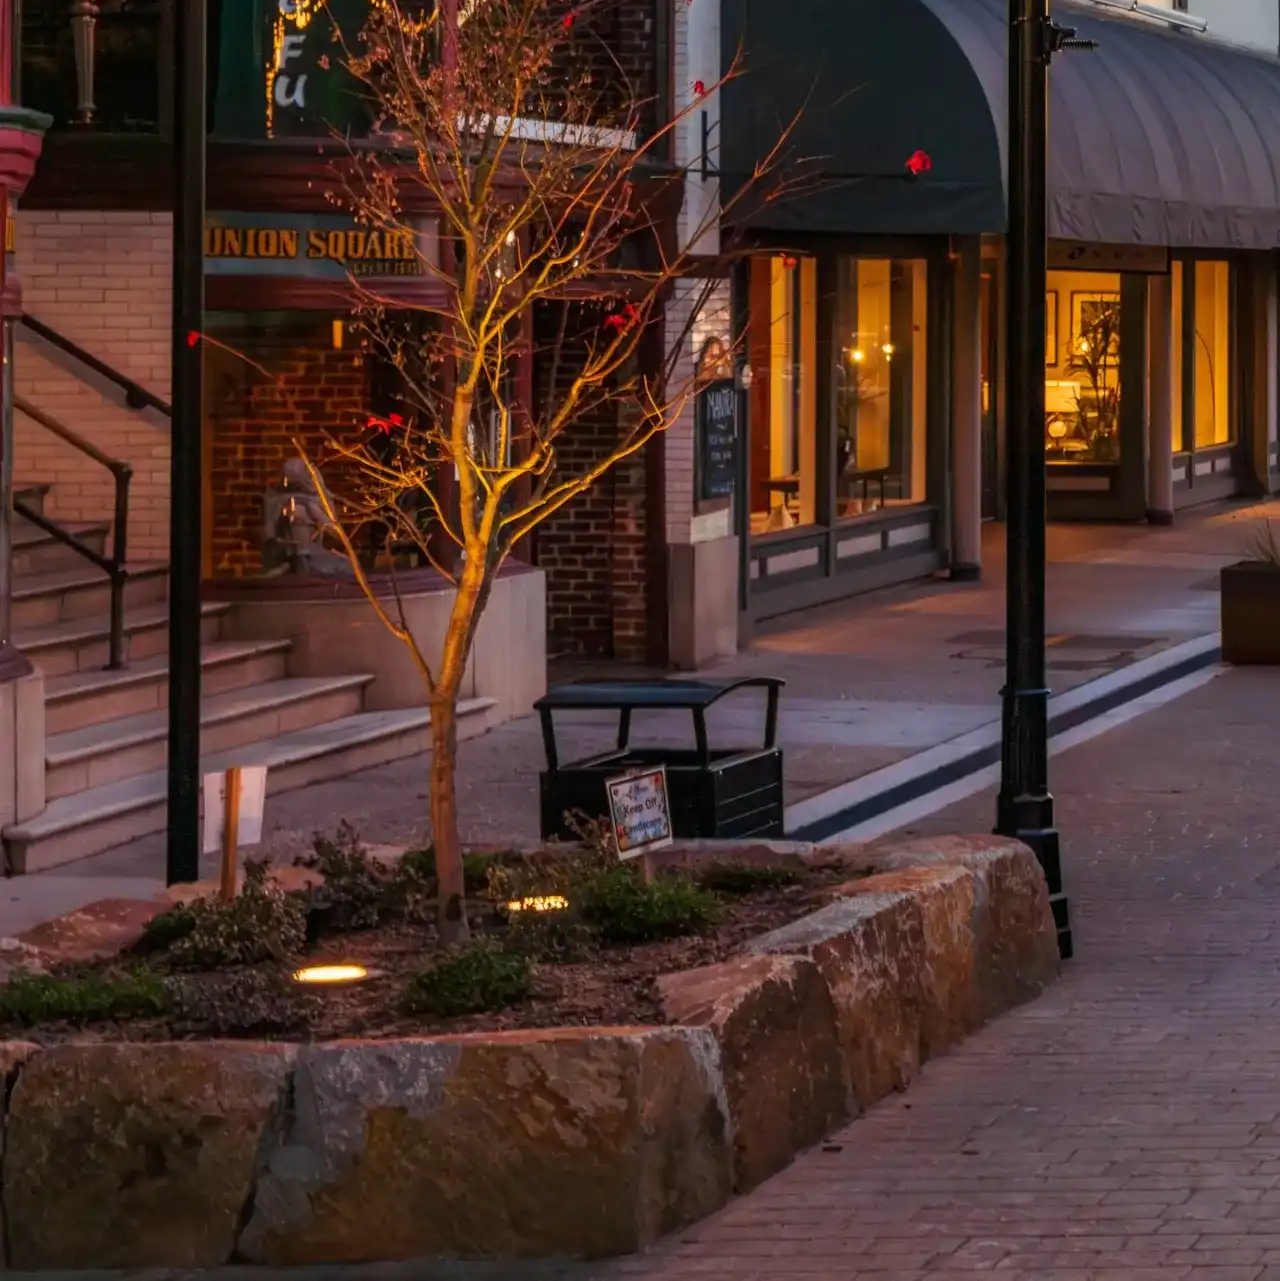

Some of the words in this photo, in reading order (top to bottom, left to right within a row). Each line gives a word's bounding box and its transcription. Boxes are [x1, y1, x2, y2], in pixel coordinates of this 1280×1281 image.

[274, 34, 308, 108] FU
[204, 227, 299, 258] UNION
[306, 227, 416, 265] SQUARE
